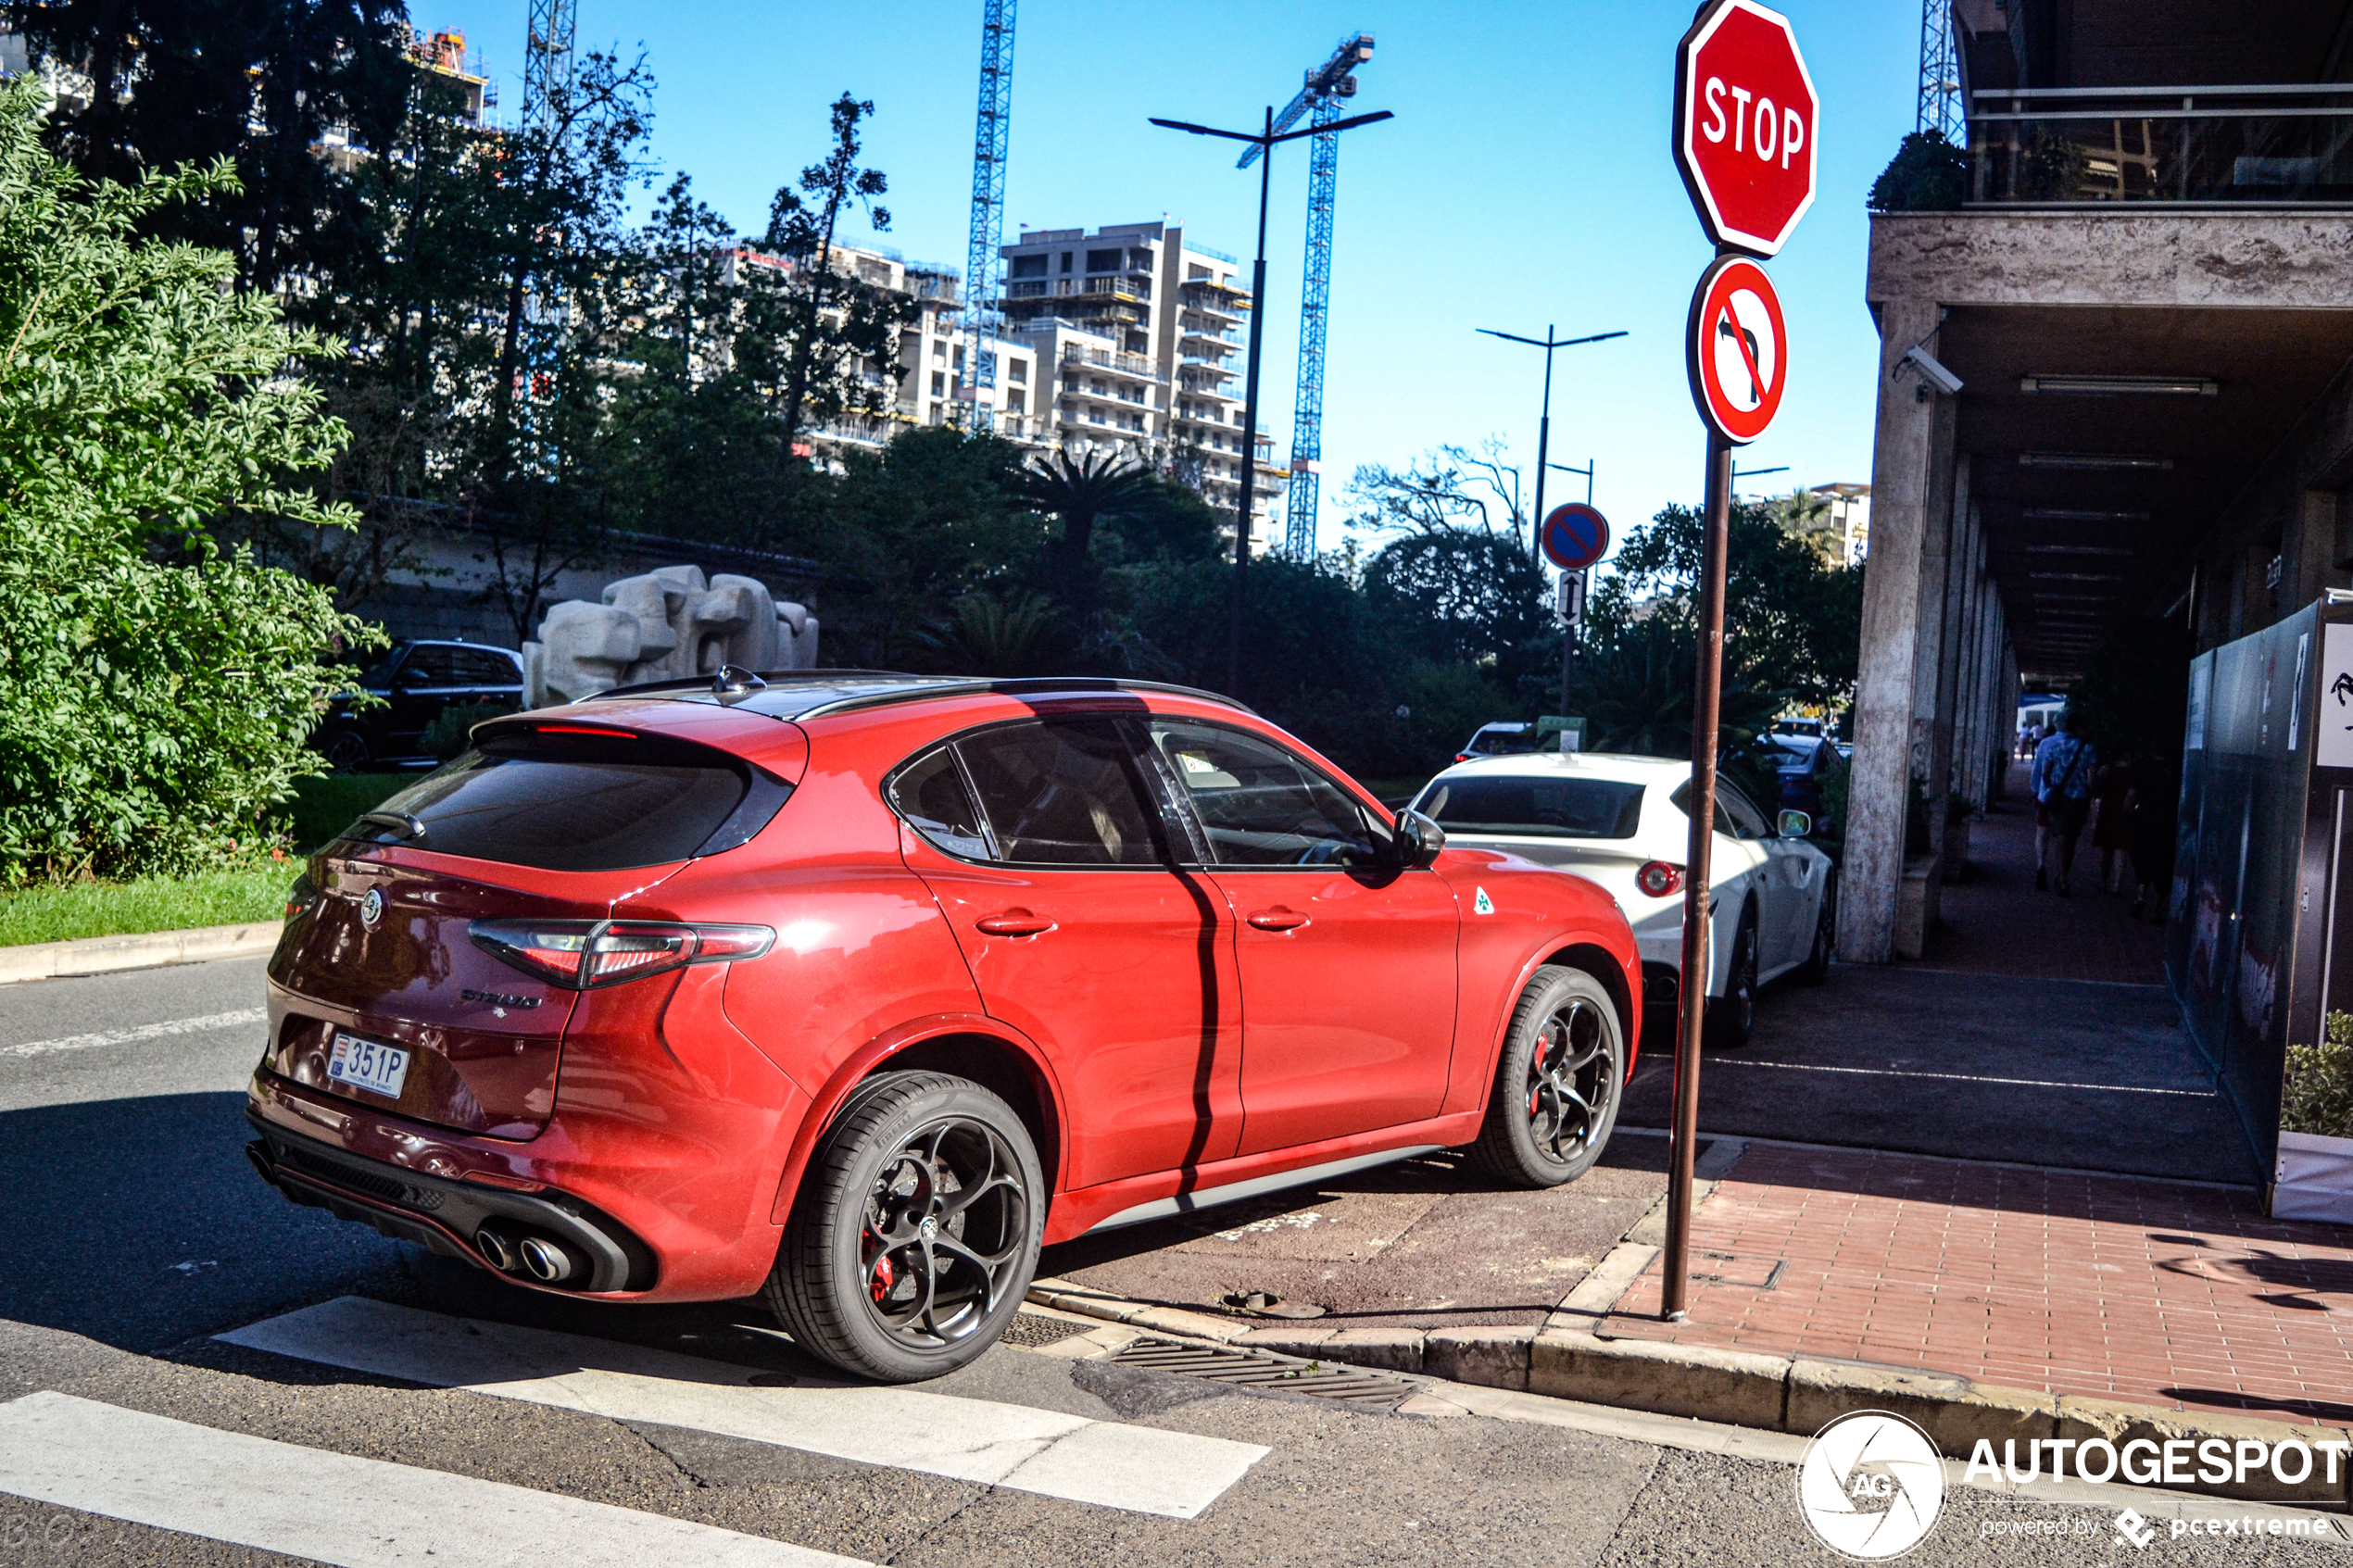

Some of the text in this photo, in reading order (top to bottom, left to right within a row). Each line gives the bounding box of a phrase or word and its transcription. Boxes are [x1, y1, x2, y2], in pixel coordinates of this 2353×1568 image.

[1703, 76, 1804, 170] STOP
[349, 1042, 401, 1083] 351P
[874, 1110, 912, 1149] PIRELLI
